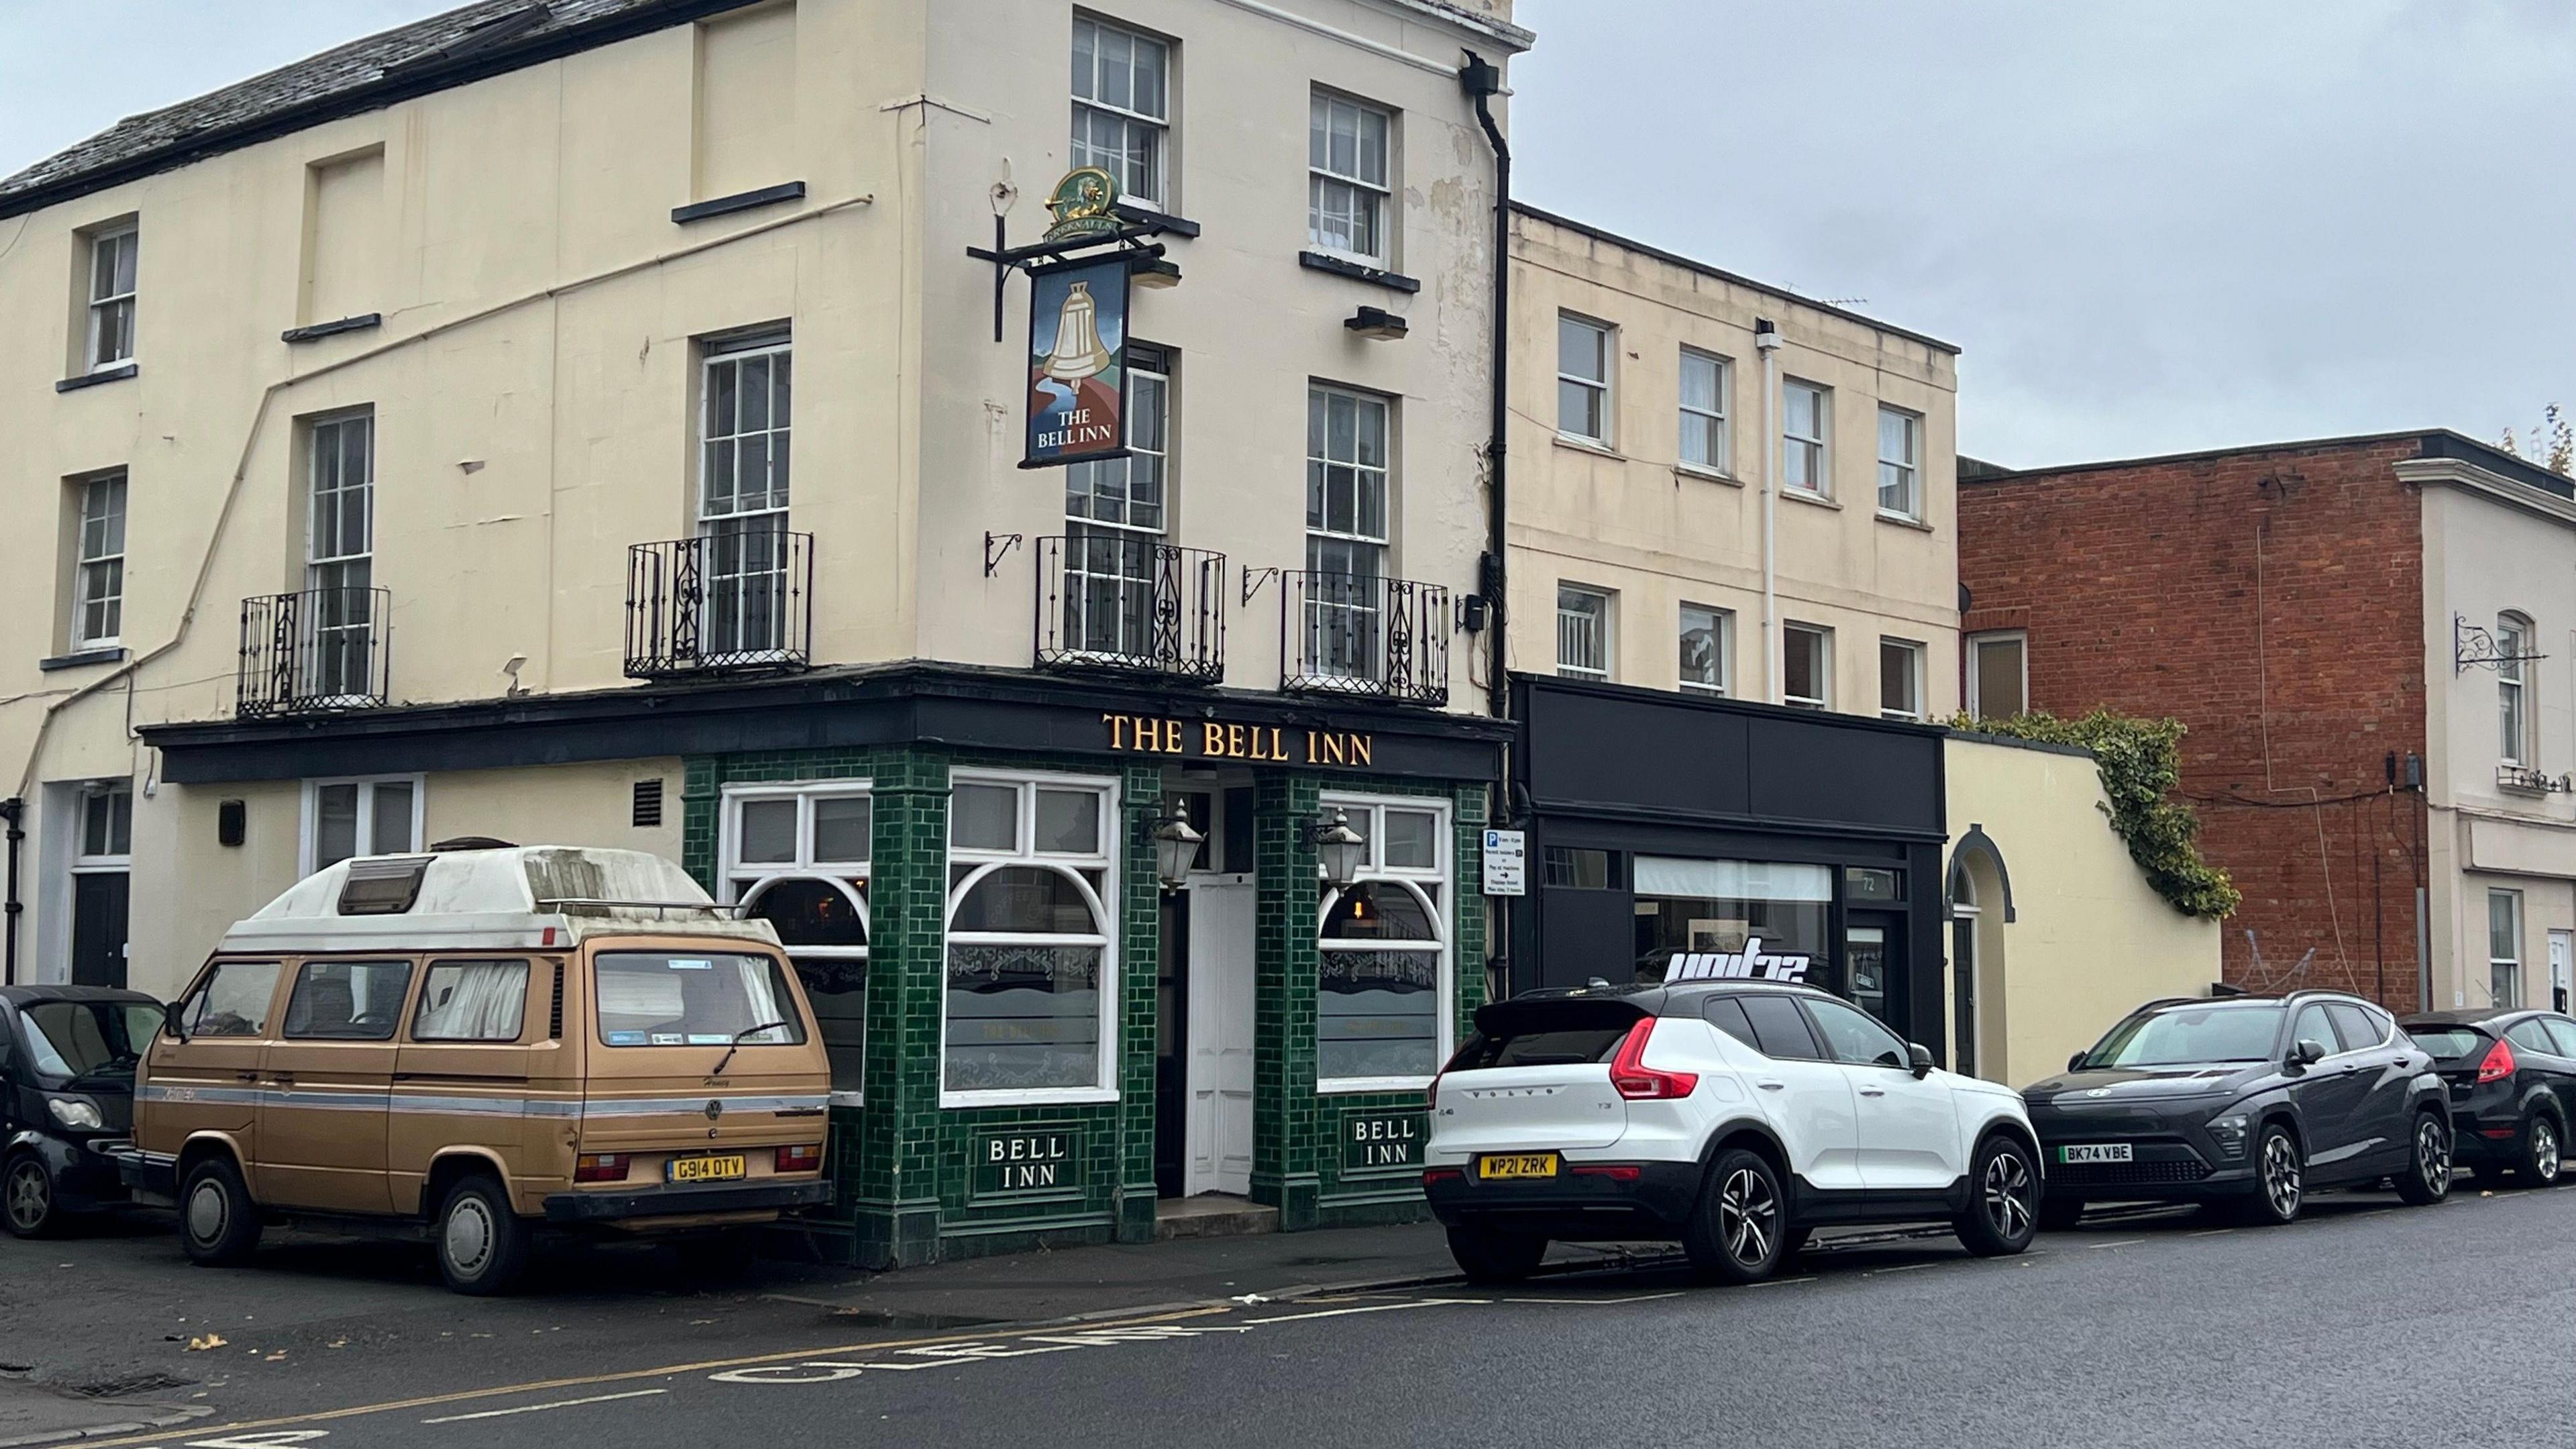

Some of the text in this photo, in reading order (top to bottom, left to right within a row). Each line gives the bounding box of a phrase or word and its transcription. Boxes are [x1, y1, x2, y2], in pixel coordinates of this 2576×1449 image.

[1058, 409, 1091, 427] THE
[1038, 424, 1112, 448] BELL INN
[1102, 713, 1371, 765] THE BELL INN
[1864, 877, 1875, 892] 72
[1355, 1119, 1414, 1140] BELL
[990, 1137, 1064, 1161] BELL
[1366, 1144, 1407, 1164] INN
[2068, 1146, 2129, 1160] BK74 VBE
[678, 1157, 740, 1177] G914 OTV
[1004, 1164, 1055, 1187] INN
[1489, 1157, 1548, 1175] WP21 ZRK
[708, 1325, 1254, 1383] CLEAR
